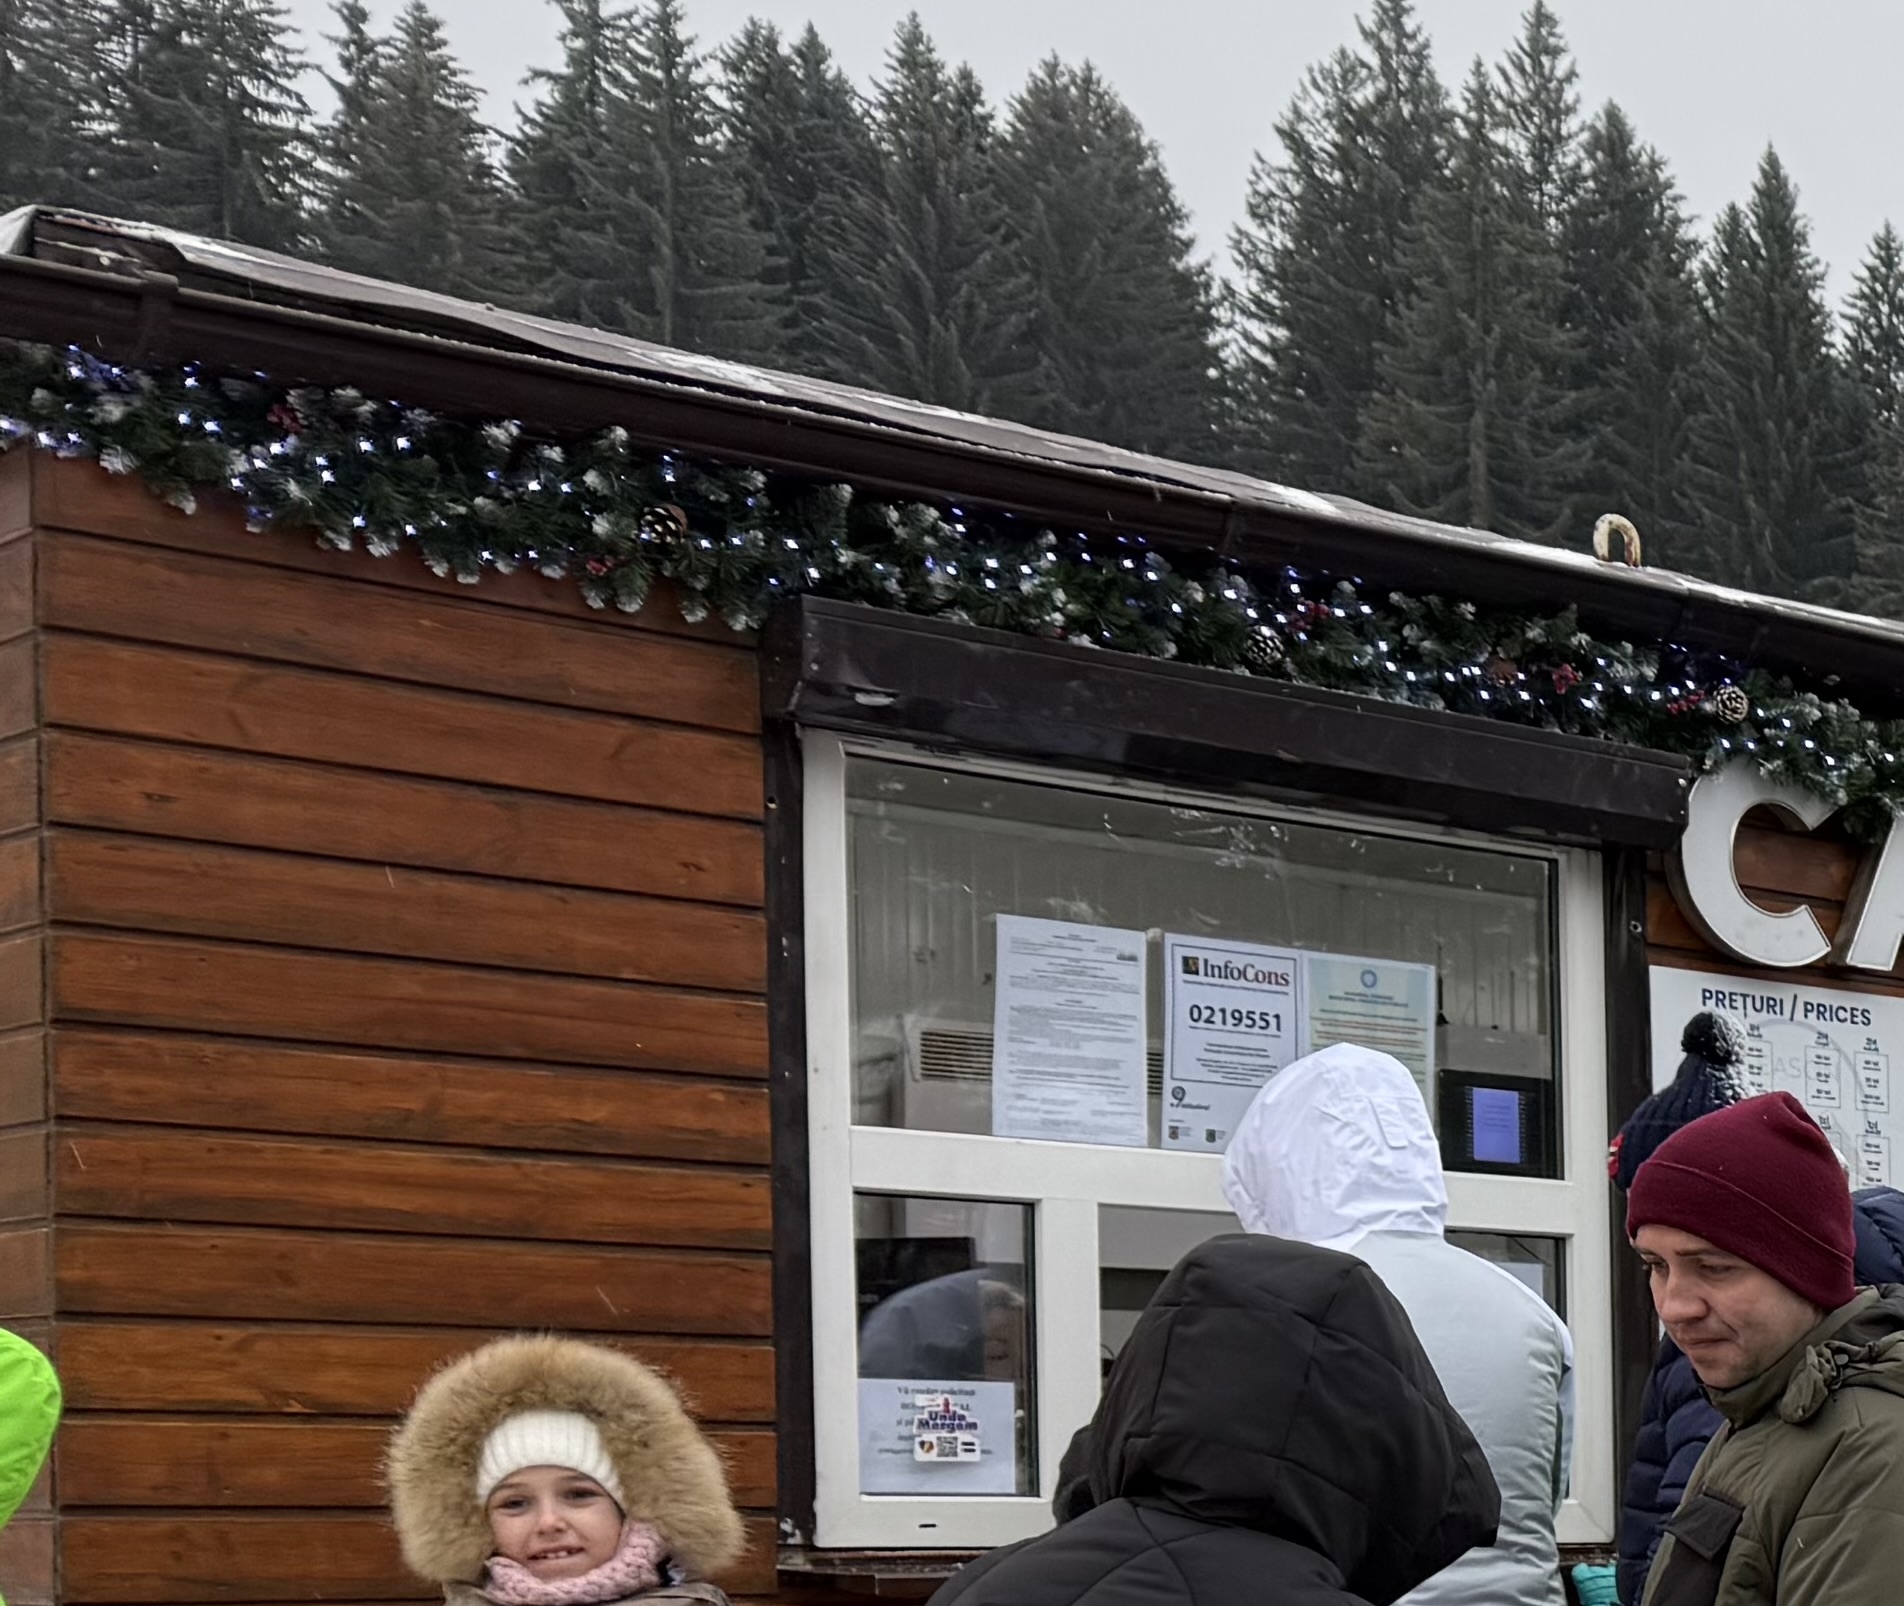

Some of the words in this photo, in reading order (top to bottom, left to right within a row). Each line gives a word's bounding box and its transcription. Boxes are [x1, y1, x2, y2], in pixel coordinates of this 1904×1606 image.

[1202, 957, 1290, 987] InfoCons
[1188, 1003, 1282, 1032] 0219551
[1803, 1001, 1872, 1027] PRICES
